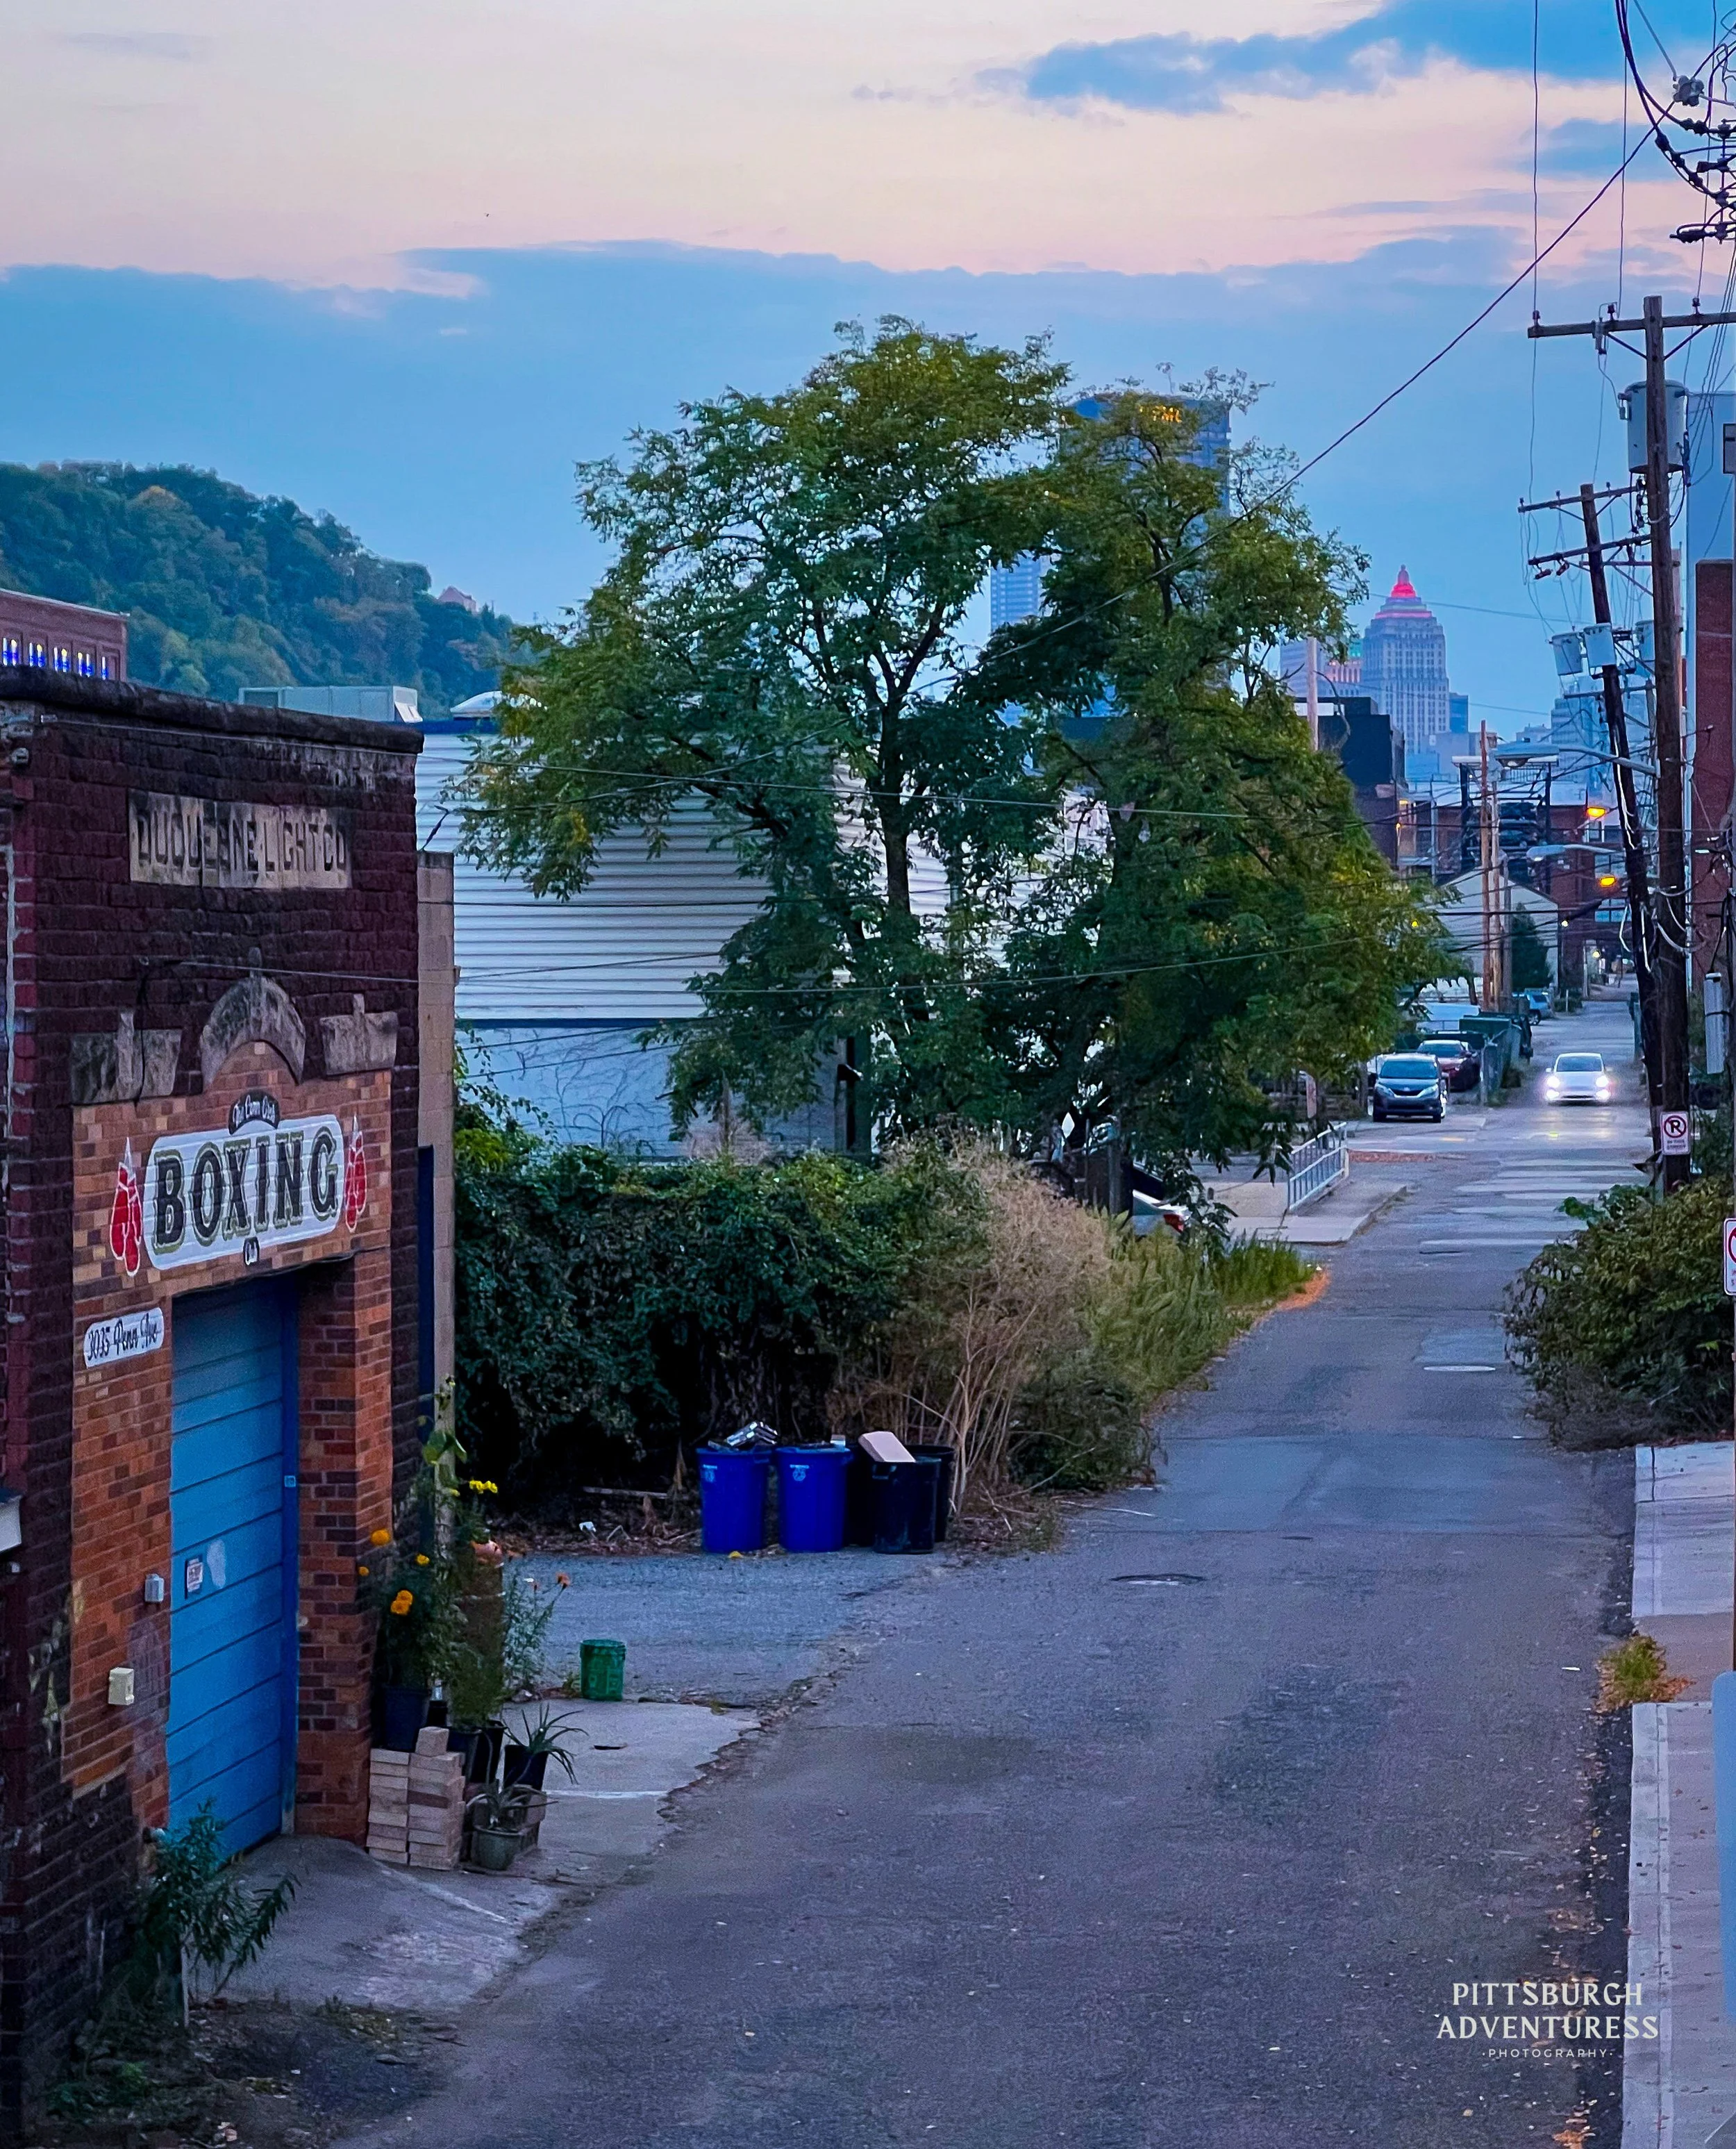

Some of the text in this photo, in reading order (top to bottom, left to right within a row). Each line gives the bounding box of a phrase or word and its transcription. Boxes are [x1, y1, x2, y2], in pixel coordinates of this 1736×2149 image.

[262, 809, 322, 874] LIGHT
[323, 822, 349, 873] CO
[153, 1126, 338, 1256] BOXING
[87, 1312, 159, 1361] 3035 Penn Ave
